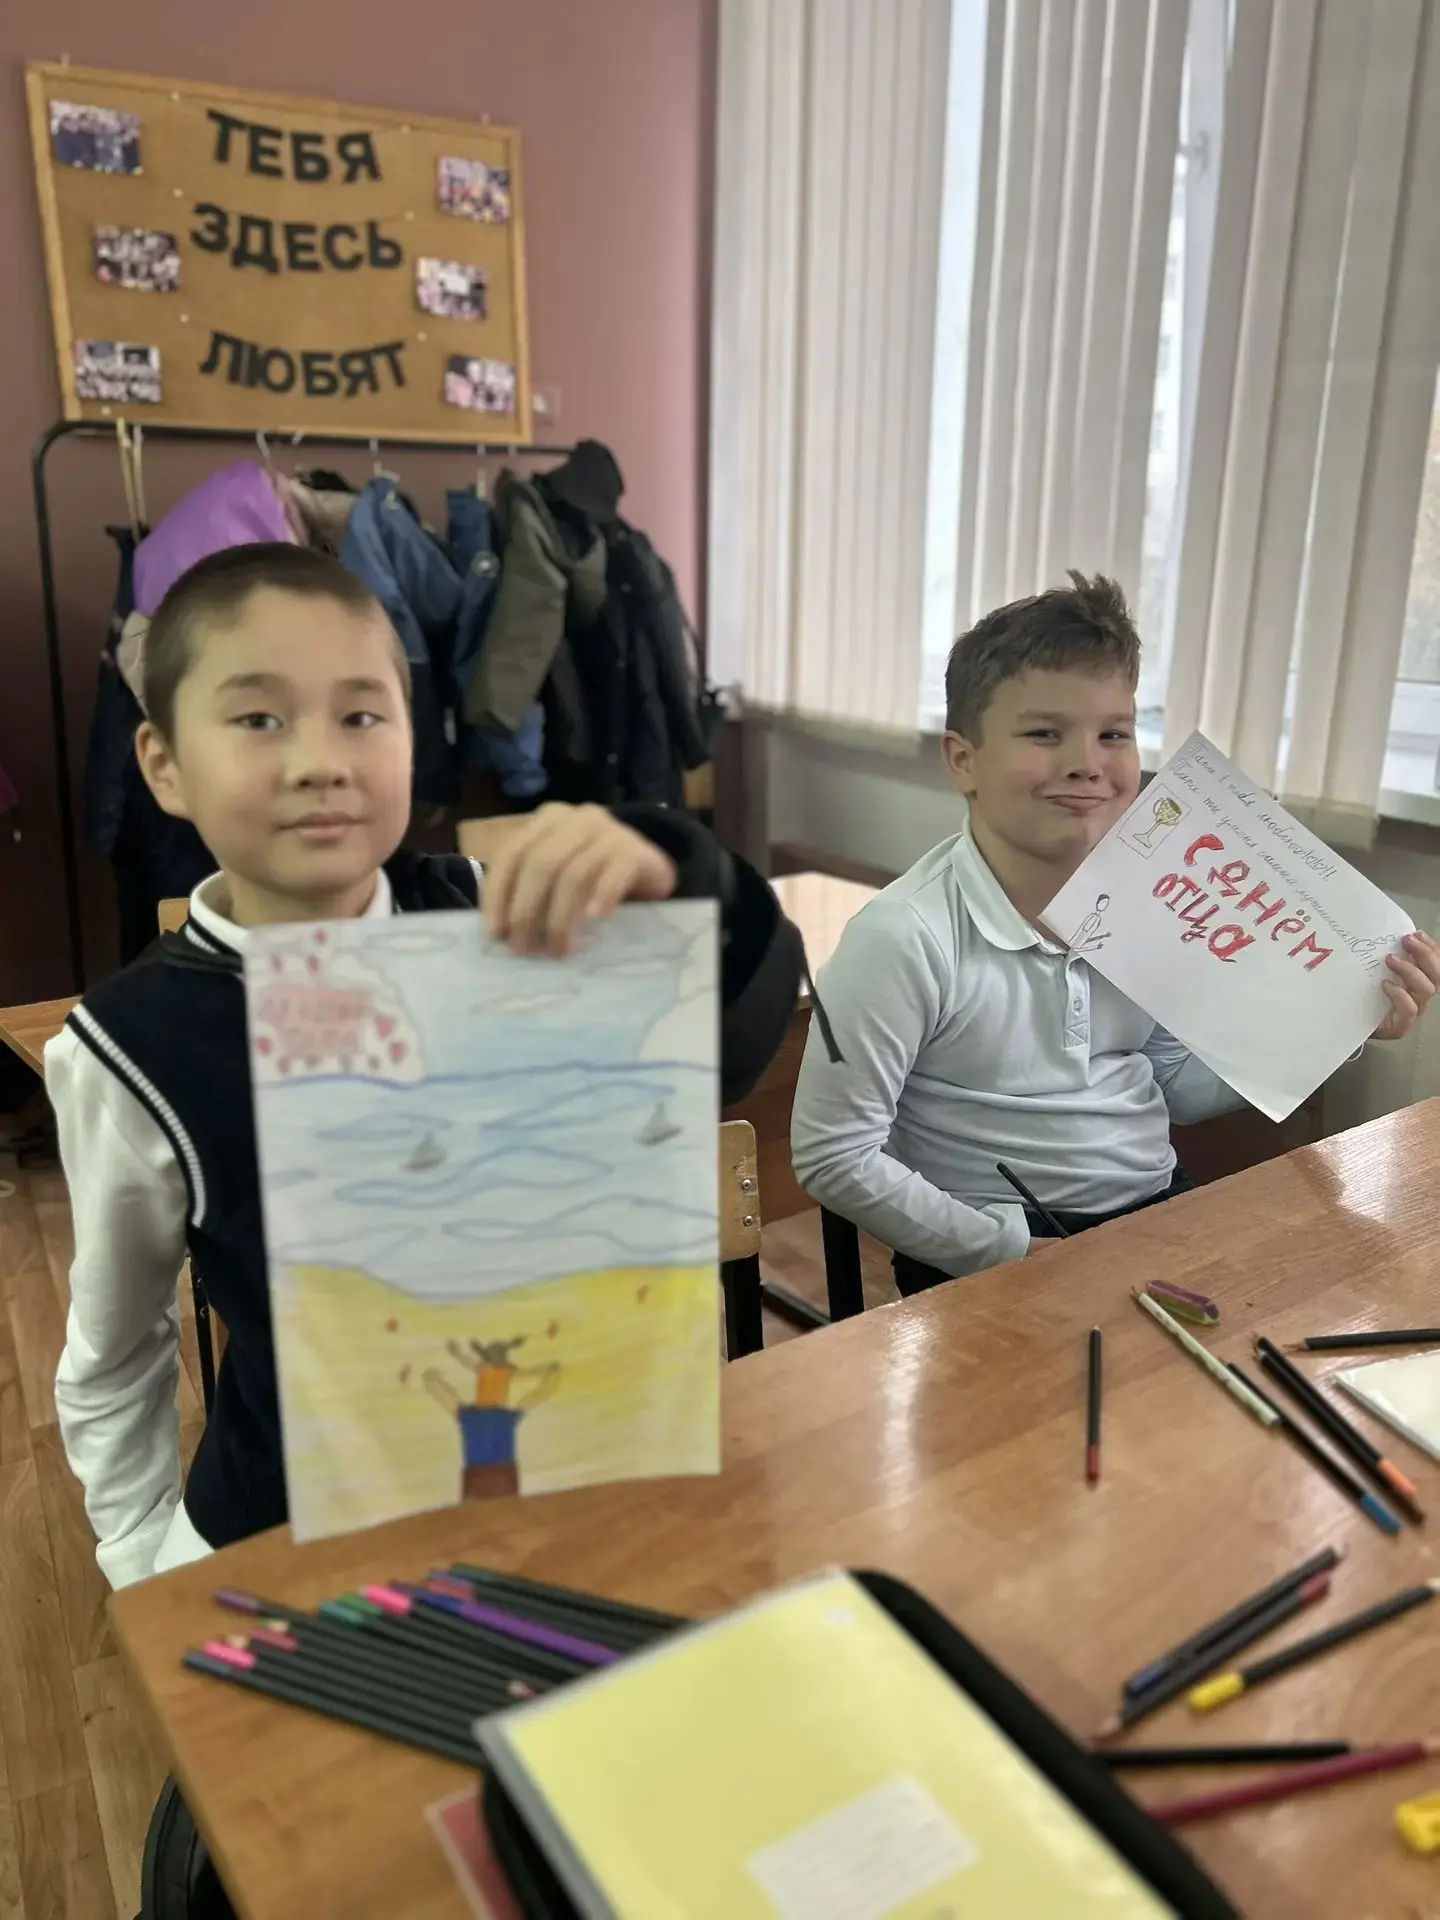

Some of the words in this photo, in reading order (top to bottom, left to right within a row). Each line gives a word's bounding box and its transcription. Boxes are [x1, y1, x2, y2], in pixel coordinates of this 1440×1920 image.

[205, 108, 383, 184] ТЕБЯ
[189, 203, 404, 275] ЗДЕСЬ
[199, 331, 407, 397] ЛЮБЯТ
